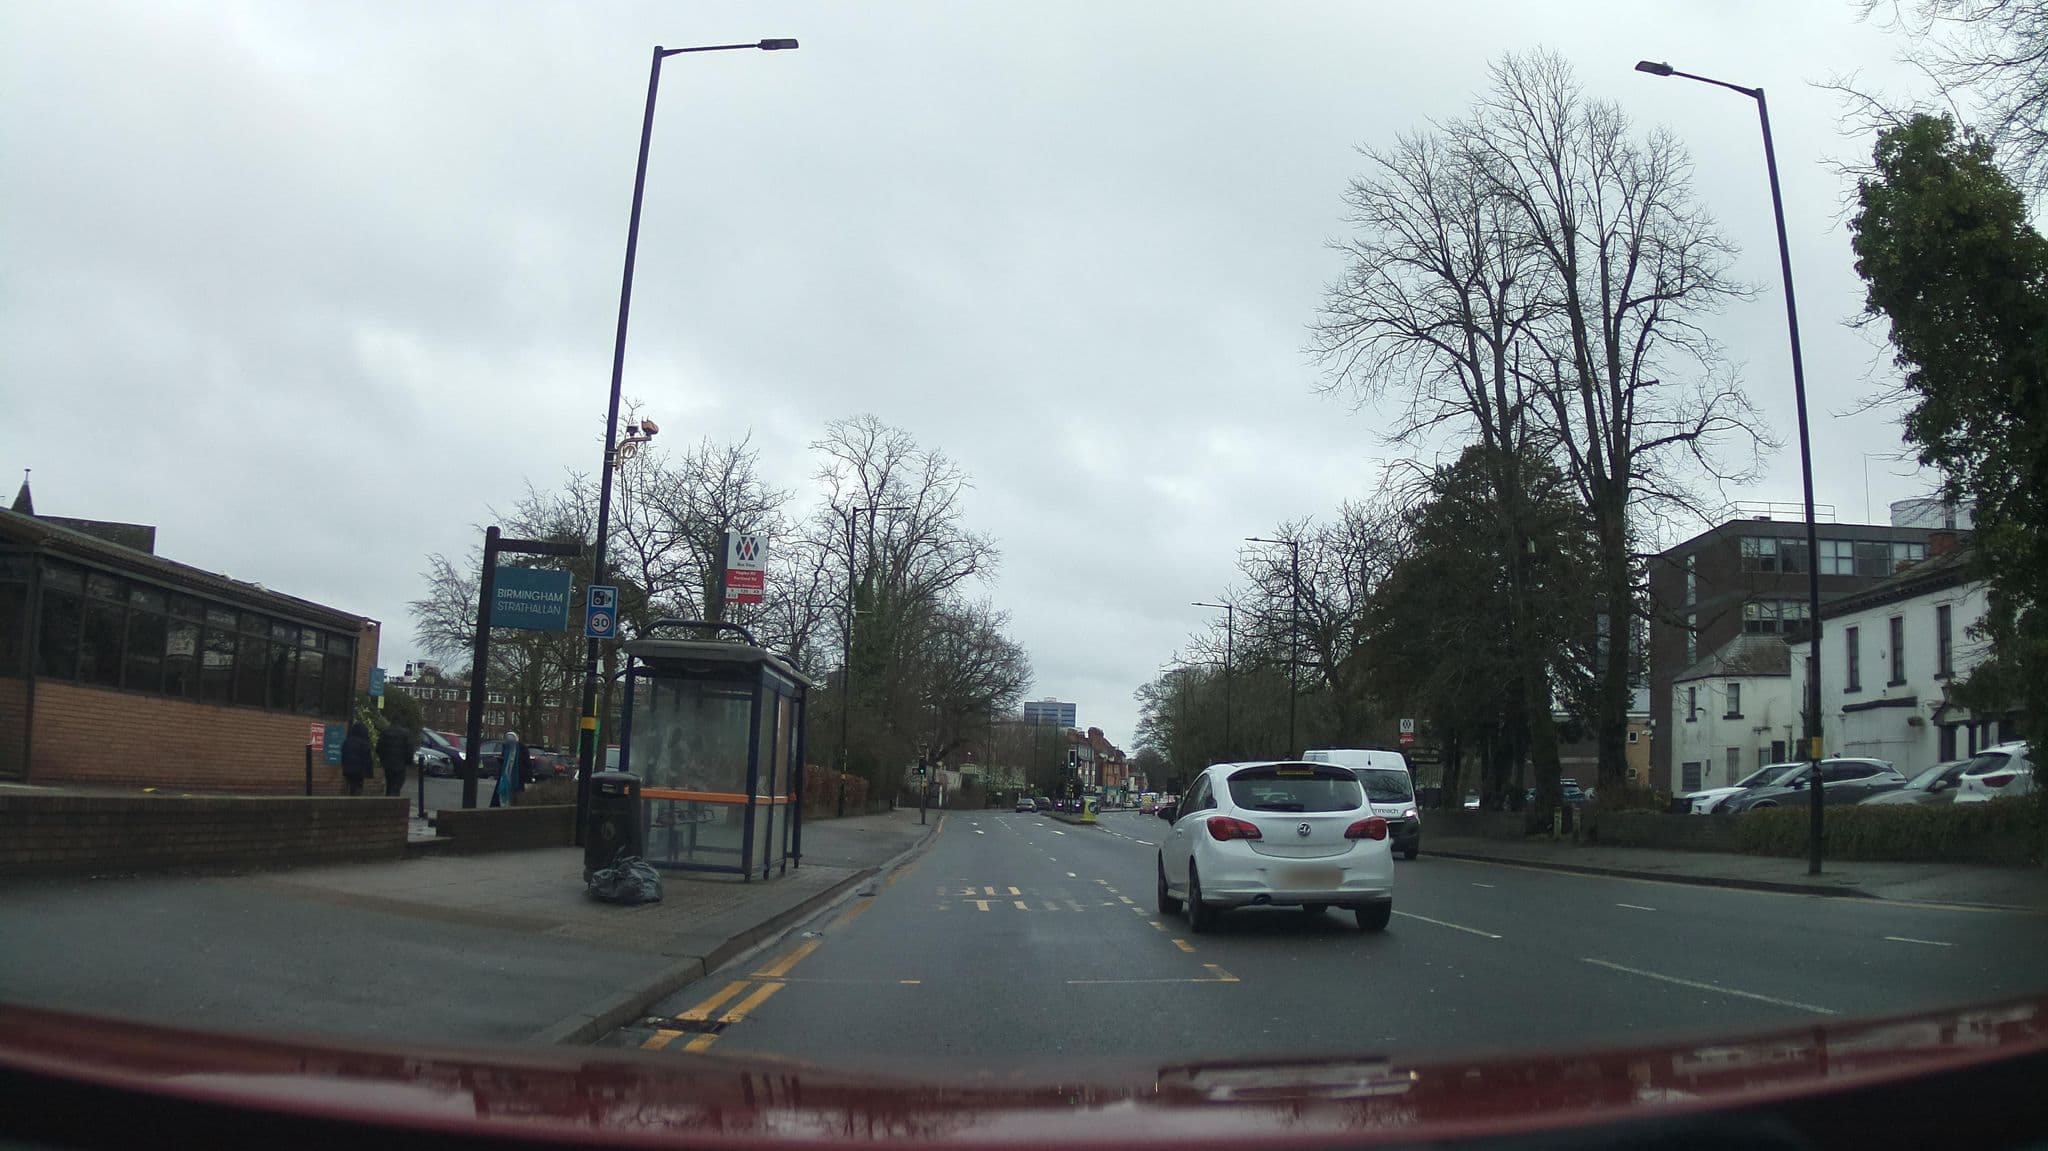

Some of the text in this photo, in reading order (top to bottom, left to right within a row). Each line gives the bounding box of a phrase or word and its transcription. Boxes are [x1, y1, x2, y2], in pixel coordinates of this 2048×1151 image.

[497, 588, 564, 602] BIRMINGHAM
[497, 600, 561, 615] STRATHALLAN
[593, 617, 609, 628] 30
